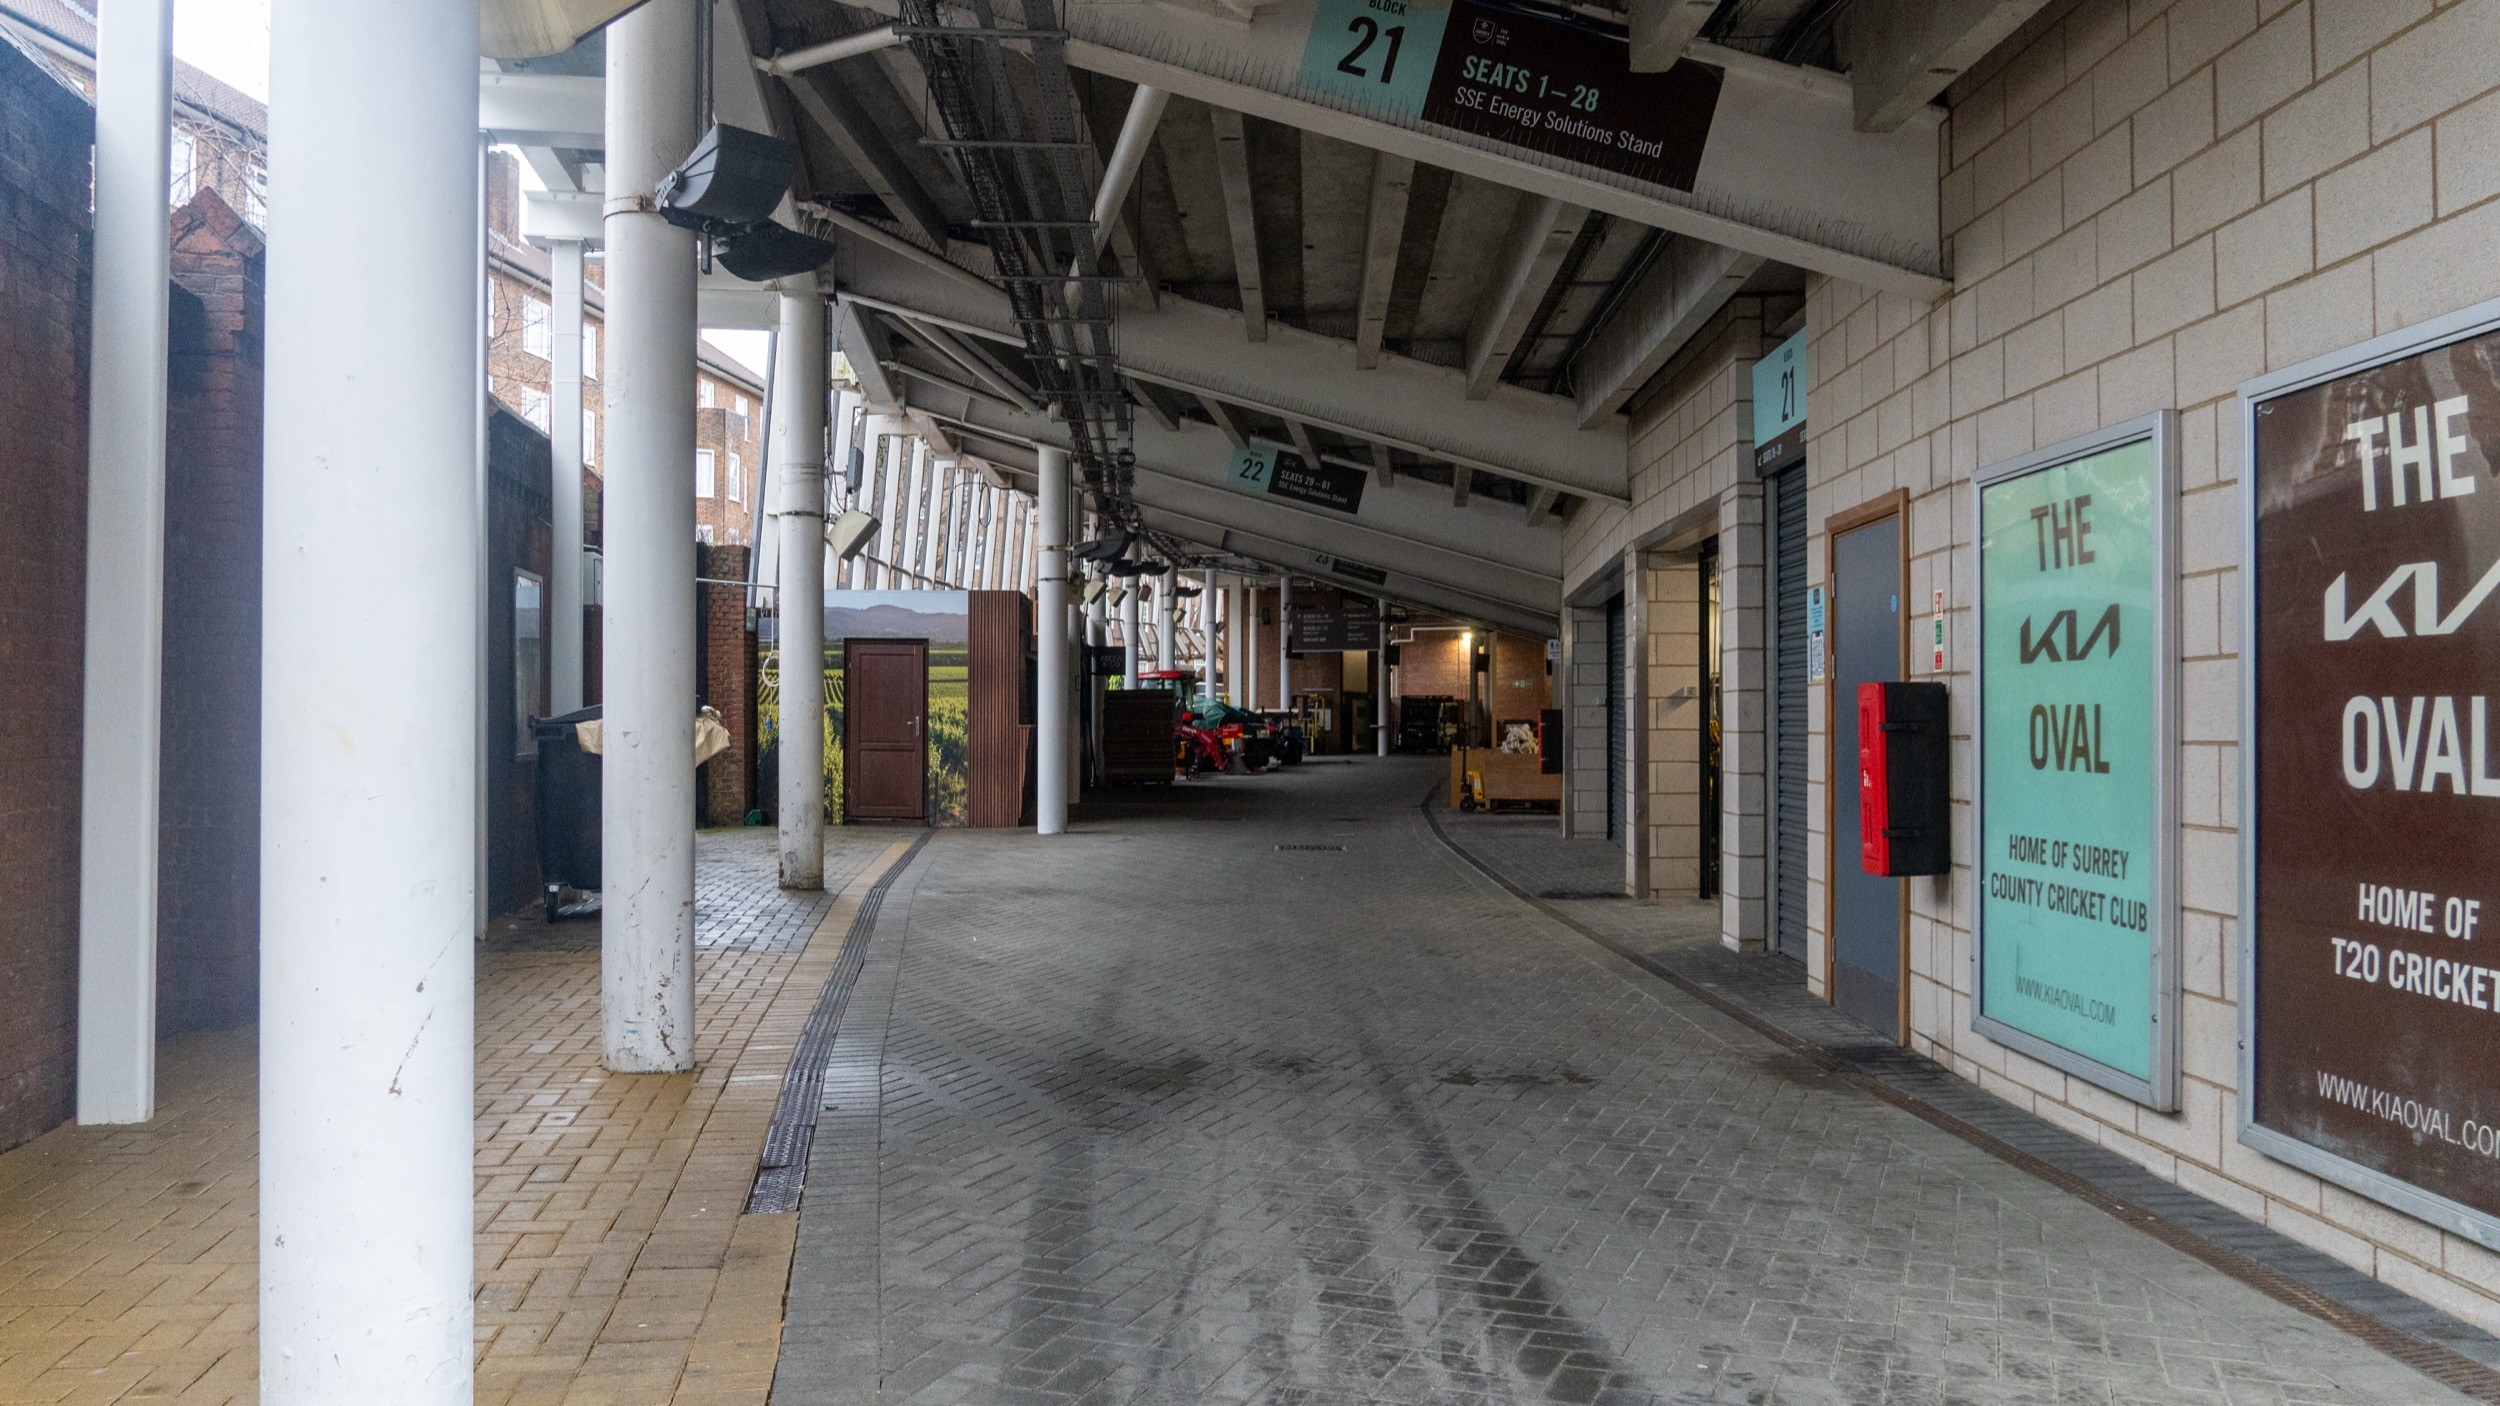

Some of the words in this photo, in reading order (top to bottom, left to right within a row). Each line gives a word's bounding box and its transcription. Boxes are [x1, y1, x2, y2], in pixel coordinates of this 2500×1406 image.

[1337, 16, 1405, 84] 21
[1462, 55, 1531, 93] SEATS
[1539, 75, 1549, 99] 1
[1570, 84, 1600, 112] 28
[1455, 86, 1487, 111] SSE
[1490, 95, 1541, 128] Energy
[1544, 110, 1613, 145] Solutions
[1617, 130, 1663, 159] Stand
[1781, 365, 1795, 423] 21
[1239, 458, 1265, 482] 22
[2346, 394, 2477, 512] THE
[2030, 494, 2095, 573] THE
[2020, 603, 2121, 665] KIA
[2029, 703, 2110, 774] OVAL
[2342, 695, 2500, 798] OVAL
[2009, 834, 2048, 866] HOME
[2052, 840, 2069, 869] OF
[2073, 843, 2130, 880] SURREY
[1991, 872, 2043, 908] COUNTY
[2049, 882, 2106, 922] CRICKET
[2110, 896, 2148, 933] CLUB
[2358, 883, 2436, 934] HOME
[2444, 896, 2481, 941] OF
[2015, 976, 2116, 1027] WWW.KIAOVAL.COM
[2331, 937, 2380, 983] T20
[2388, 949, 2500, 1014] CRICKET
